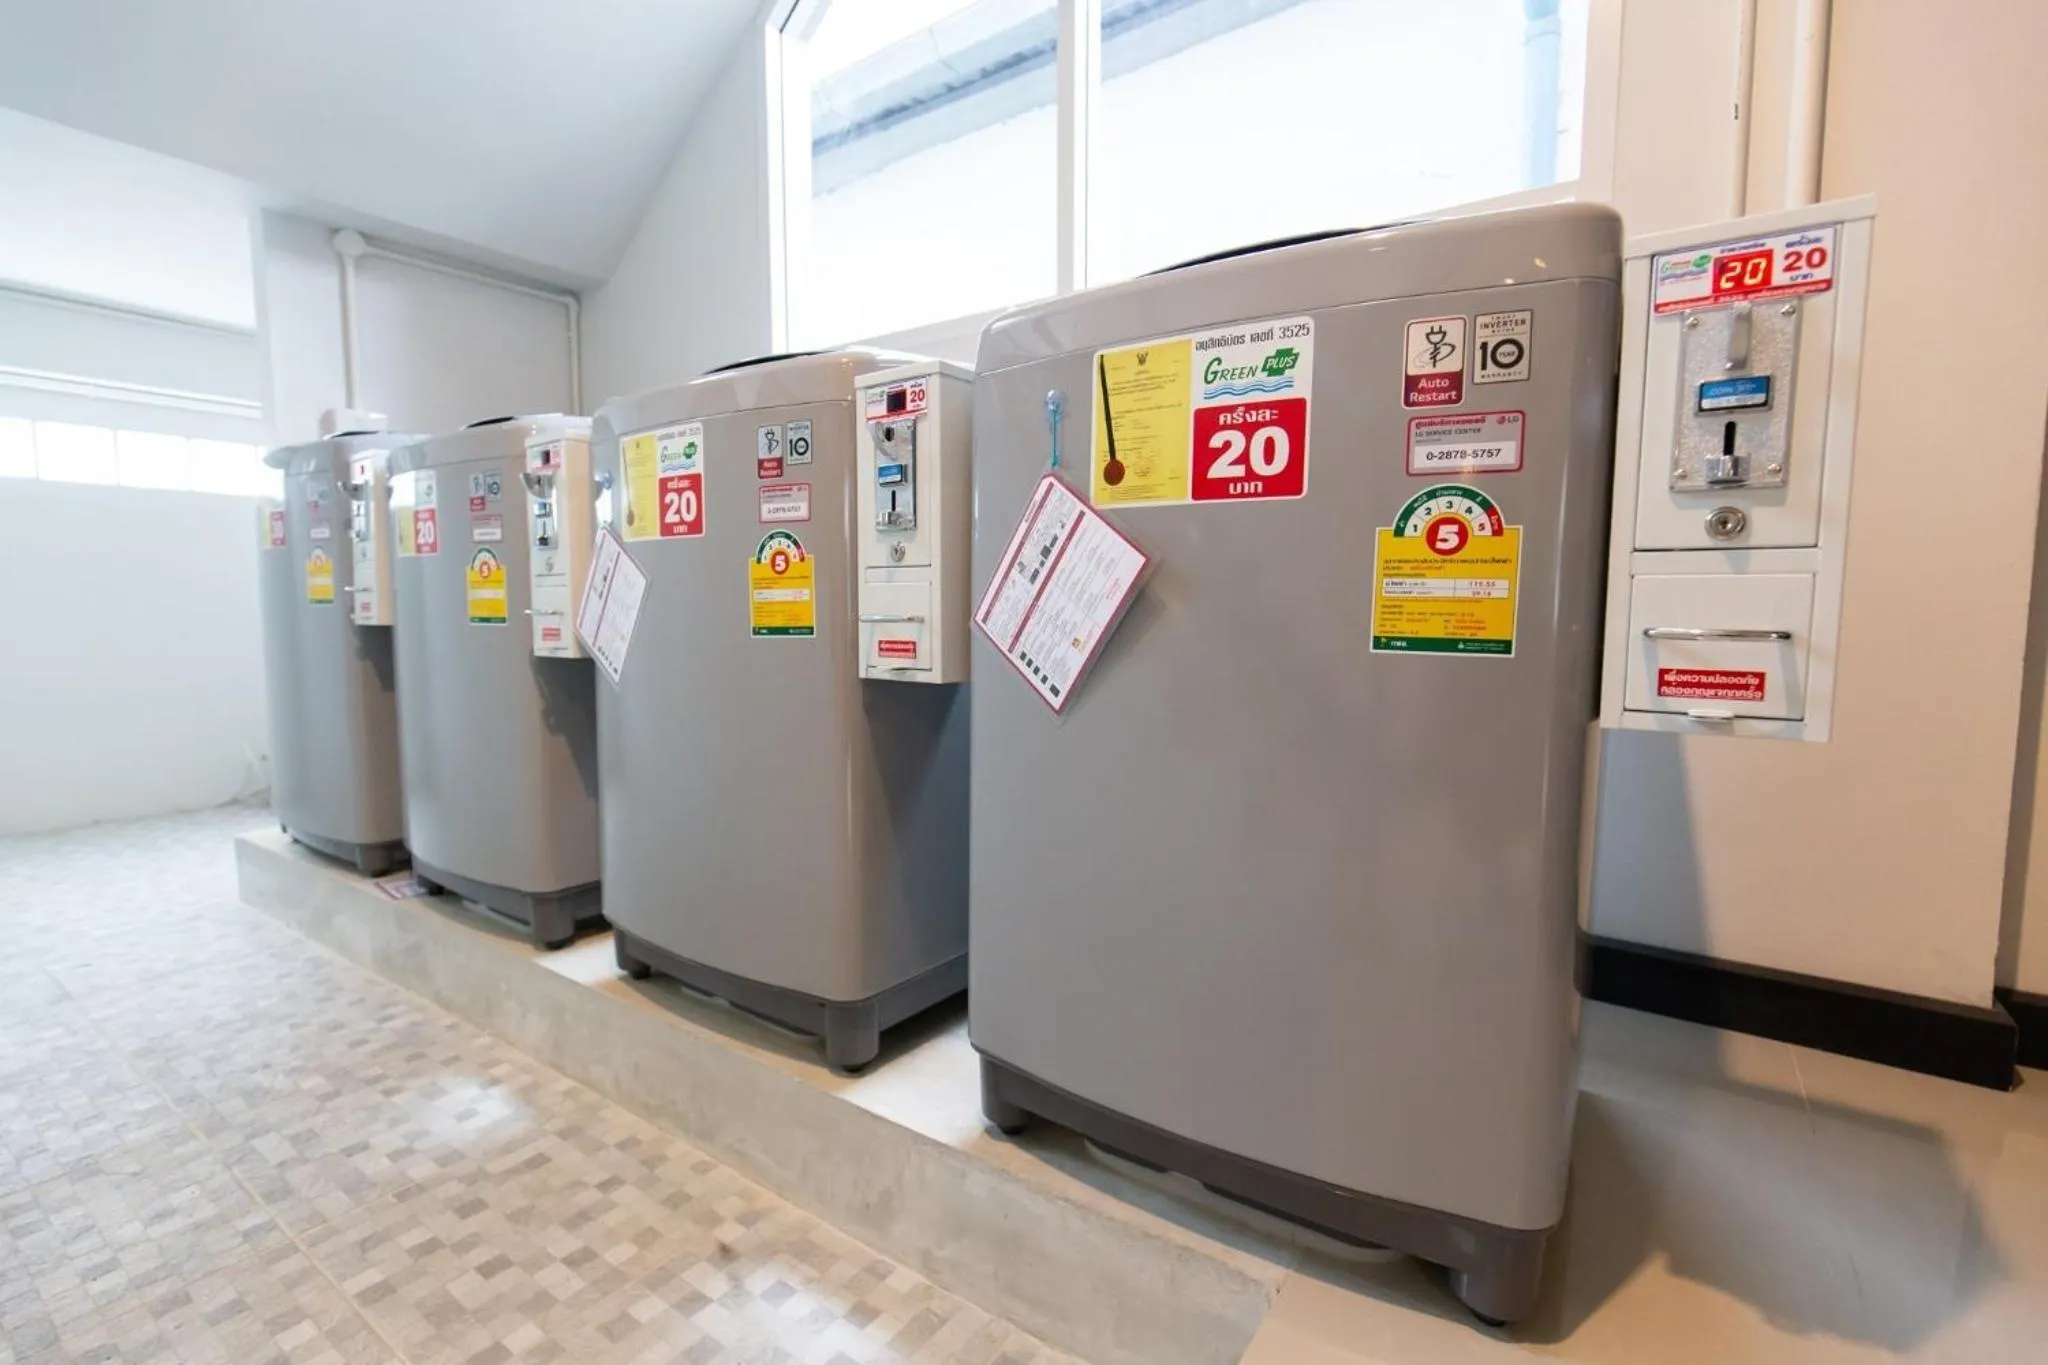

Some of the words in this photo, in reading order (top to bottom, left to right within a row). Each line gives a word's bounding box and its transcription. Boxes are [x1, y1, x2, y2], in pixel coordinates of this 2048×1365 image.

[1782, 247, 1828, 272] 20
[1720, 257, 1767, 289] 20
[1279, 323, 1311, 339] 3525
[1480, 338, 1525, 371] 10
[1204, 357, 1258, 385] GREEN
[1267, 356, 1296, 368] PLUS
[1418, 377, 1450, 389] Auto
[910, 389, 925, 403] 20
[1409, 390, 1457, 403] Restart
[1219, 407, 1279, 425] ครั้งละ
[1455, 427, 1481, 435] CENTER
[789, 437, 809, 457] 10
[1207, 425, 1291, 479] 20
[1426, 448, 1502, 461] 0-2878-5757
[1229, 481, 1263, 494] บาท
[664, 490, 697, 524] 20
[1413, 524, 1418, 532] 1
[1424, 507, 1432, 515] 2
[1445, 501, 1453, 509] 3
[1465, 506, 1473, 514] 4
[1478, 523, 1485, 531] 5
[416, 520, 435, 544] 20
[1435, 524, 1460, 550] 5
[774, 554, 786, 572] 5
